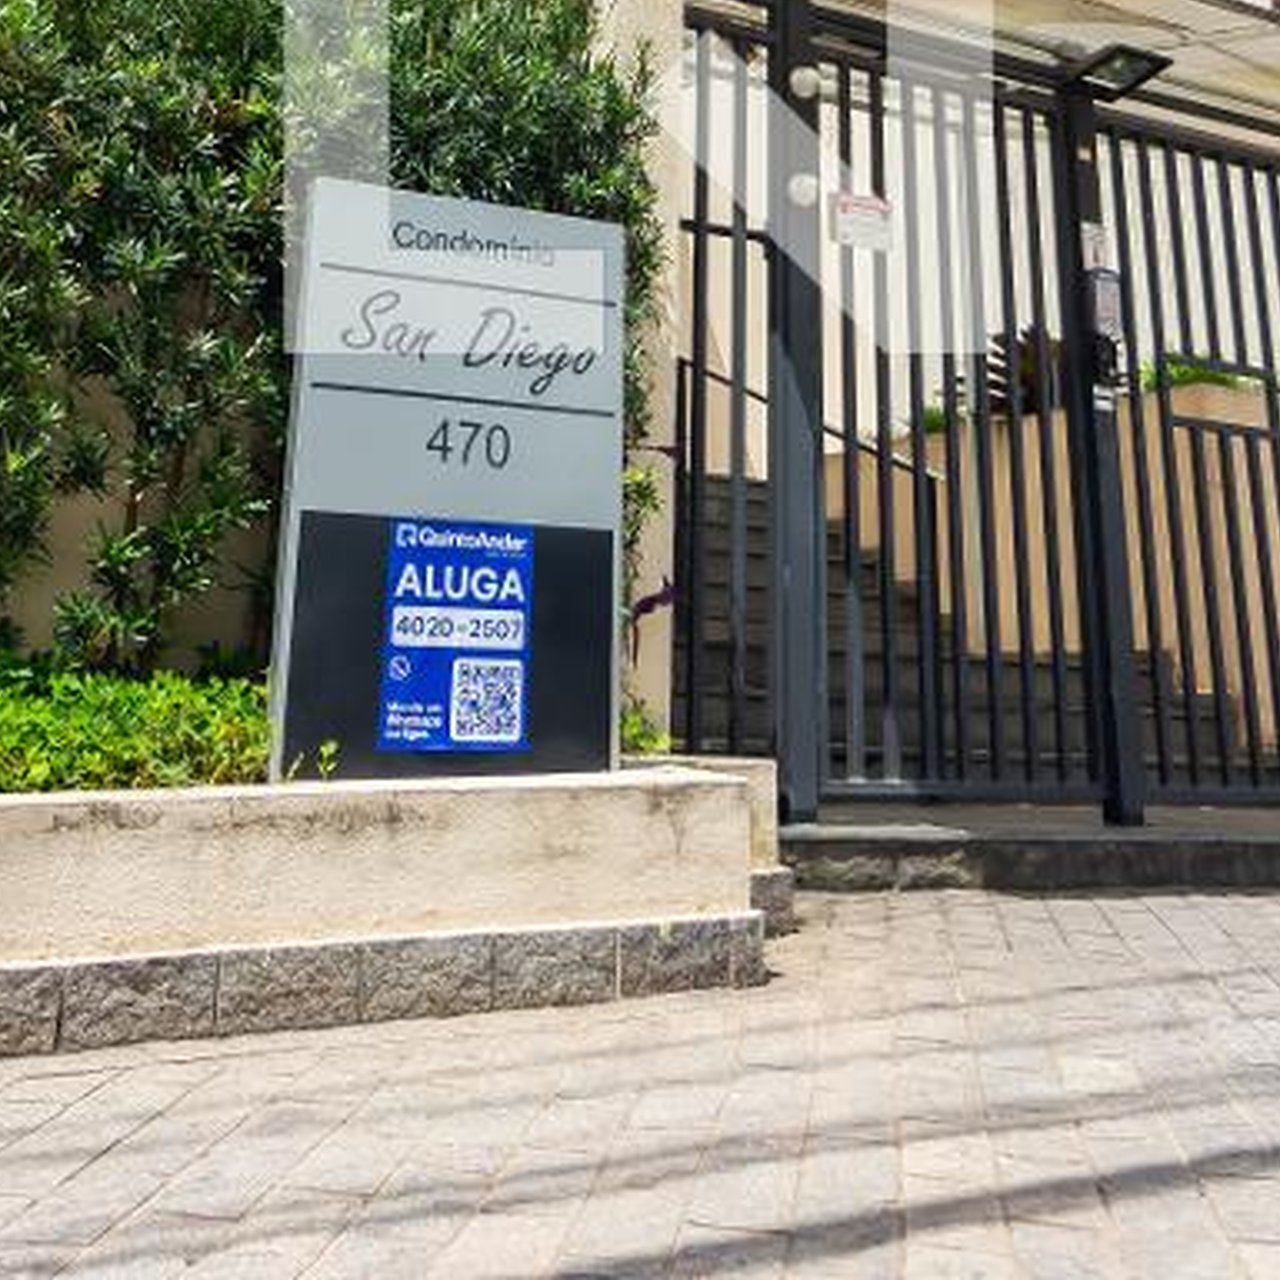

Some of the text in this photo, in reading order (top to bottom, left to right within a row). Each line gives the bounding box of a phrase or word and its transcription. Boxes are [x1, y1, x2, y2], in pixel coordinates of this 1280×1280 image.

[341, 290, 596, 396] San Diego
[426, 420, 510, 468] 470
[394, 563, 525, 603] ALUGA
